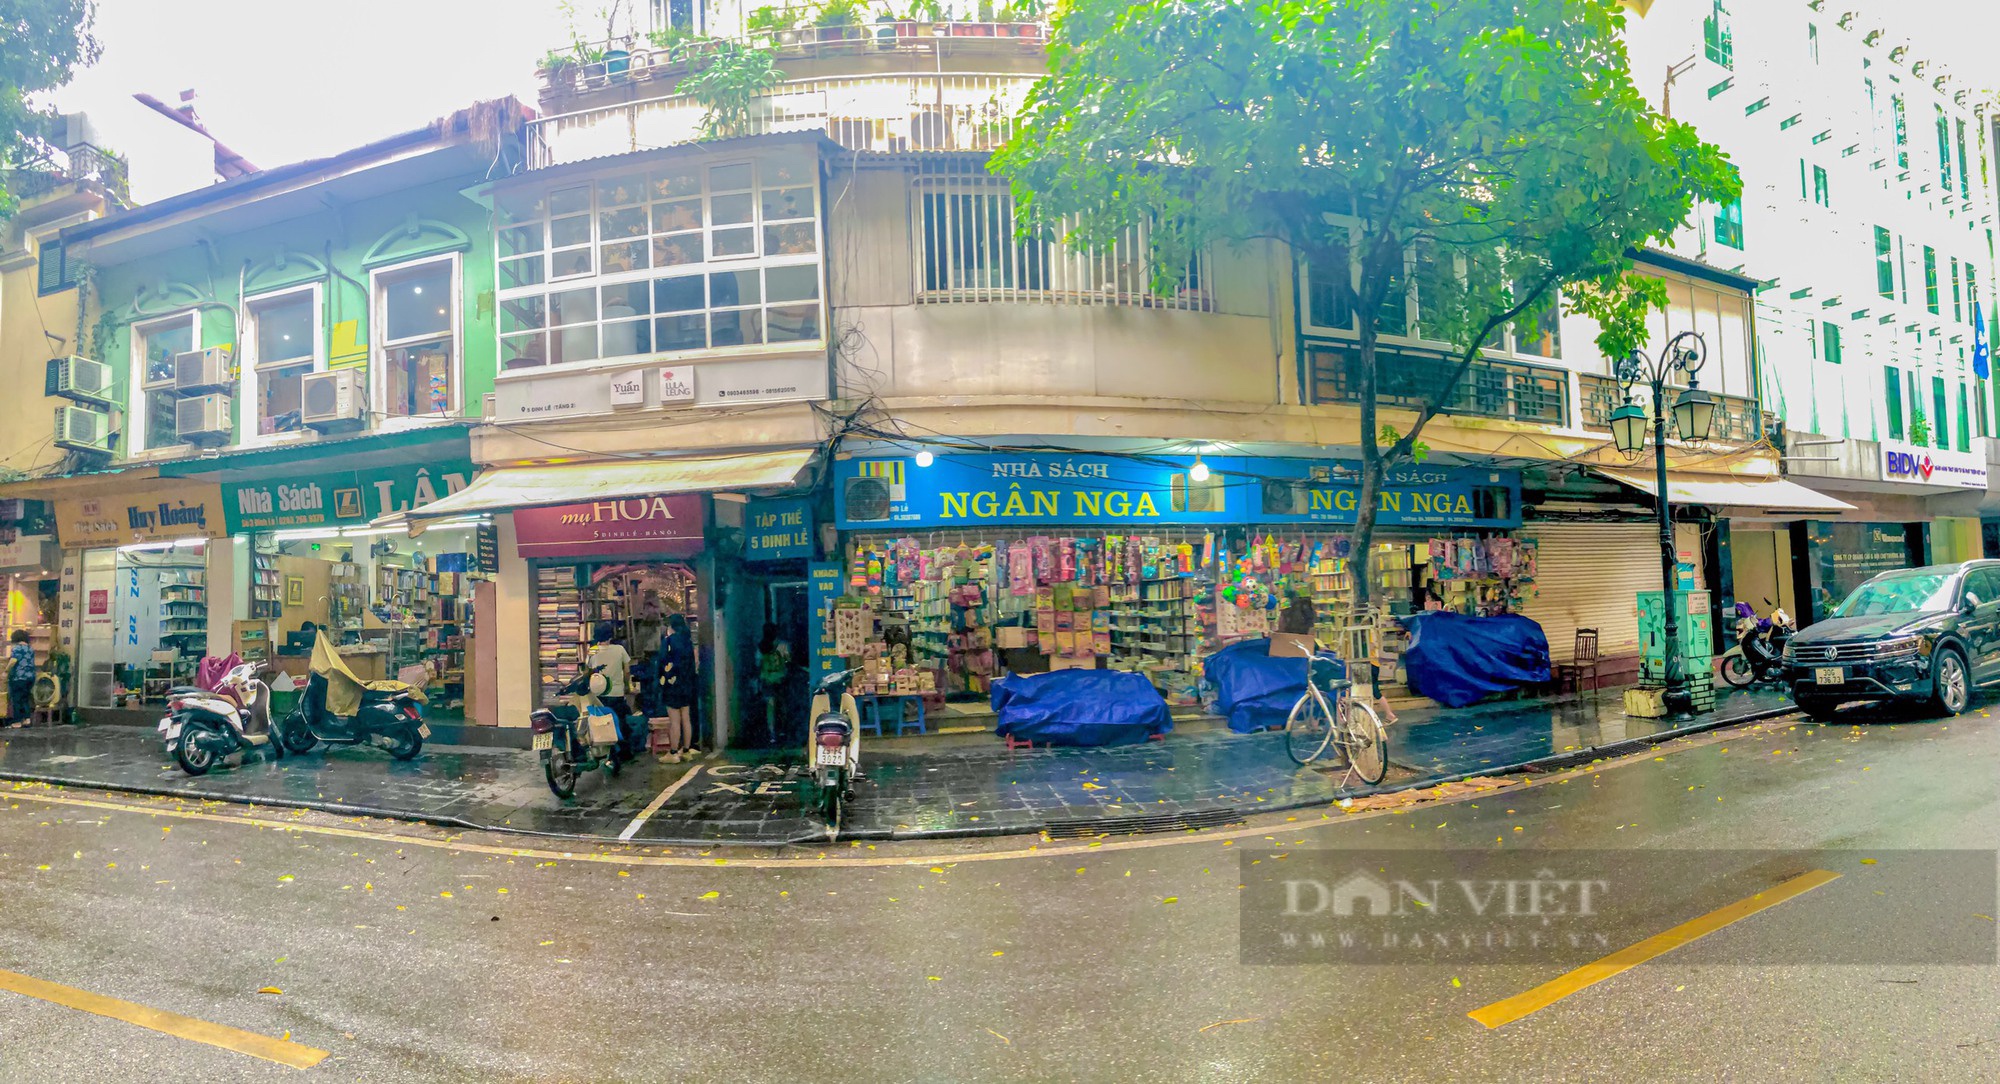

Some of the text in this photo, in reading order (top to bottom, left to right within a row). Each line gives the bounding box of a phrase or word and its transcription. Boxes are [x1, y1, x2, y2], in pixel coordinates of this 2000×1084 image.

[666, 381, 684, 389] LULA
[666, 388, 691, 396] LEUNG
[992, 458, 1109, 478] NHÀ SÁCH
[1888, 451, 1920, 476] BIDV
[238, 482, 323, 514] Nhà Sách
[593, 497, 674, 522] HOA
[939, 482, 1160, 518] NGÂN NGA
[1309, 489, 1473, 514] NGN NGA
[127, 500, 206, 533] Huy Hoàng
[751, 536, 759, 550] 5
[702, 781, 797, 795] XE
